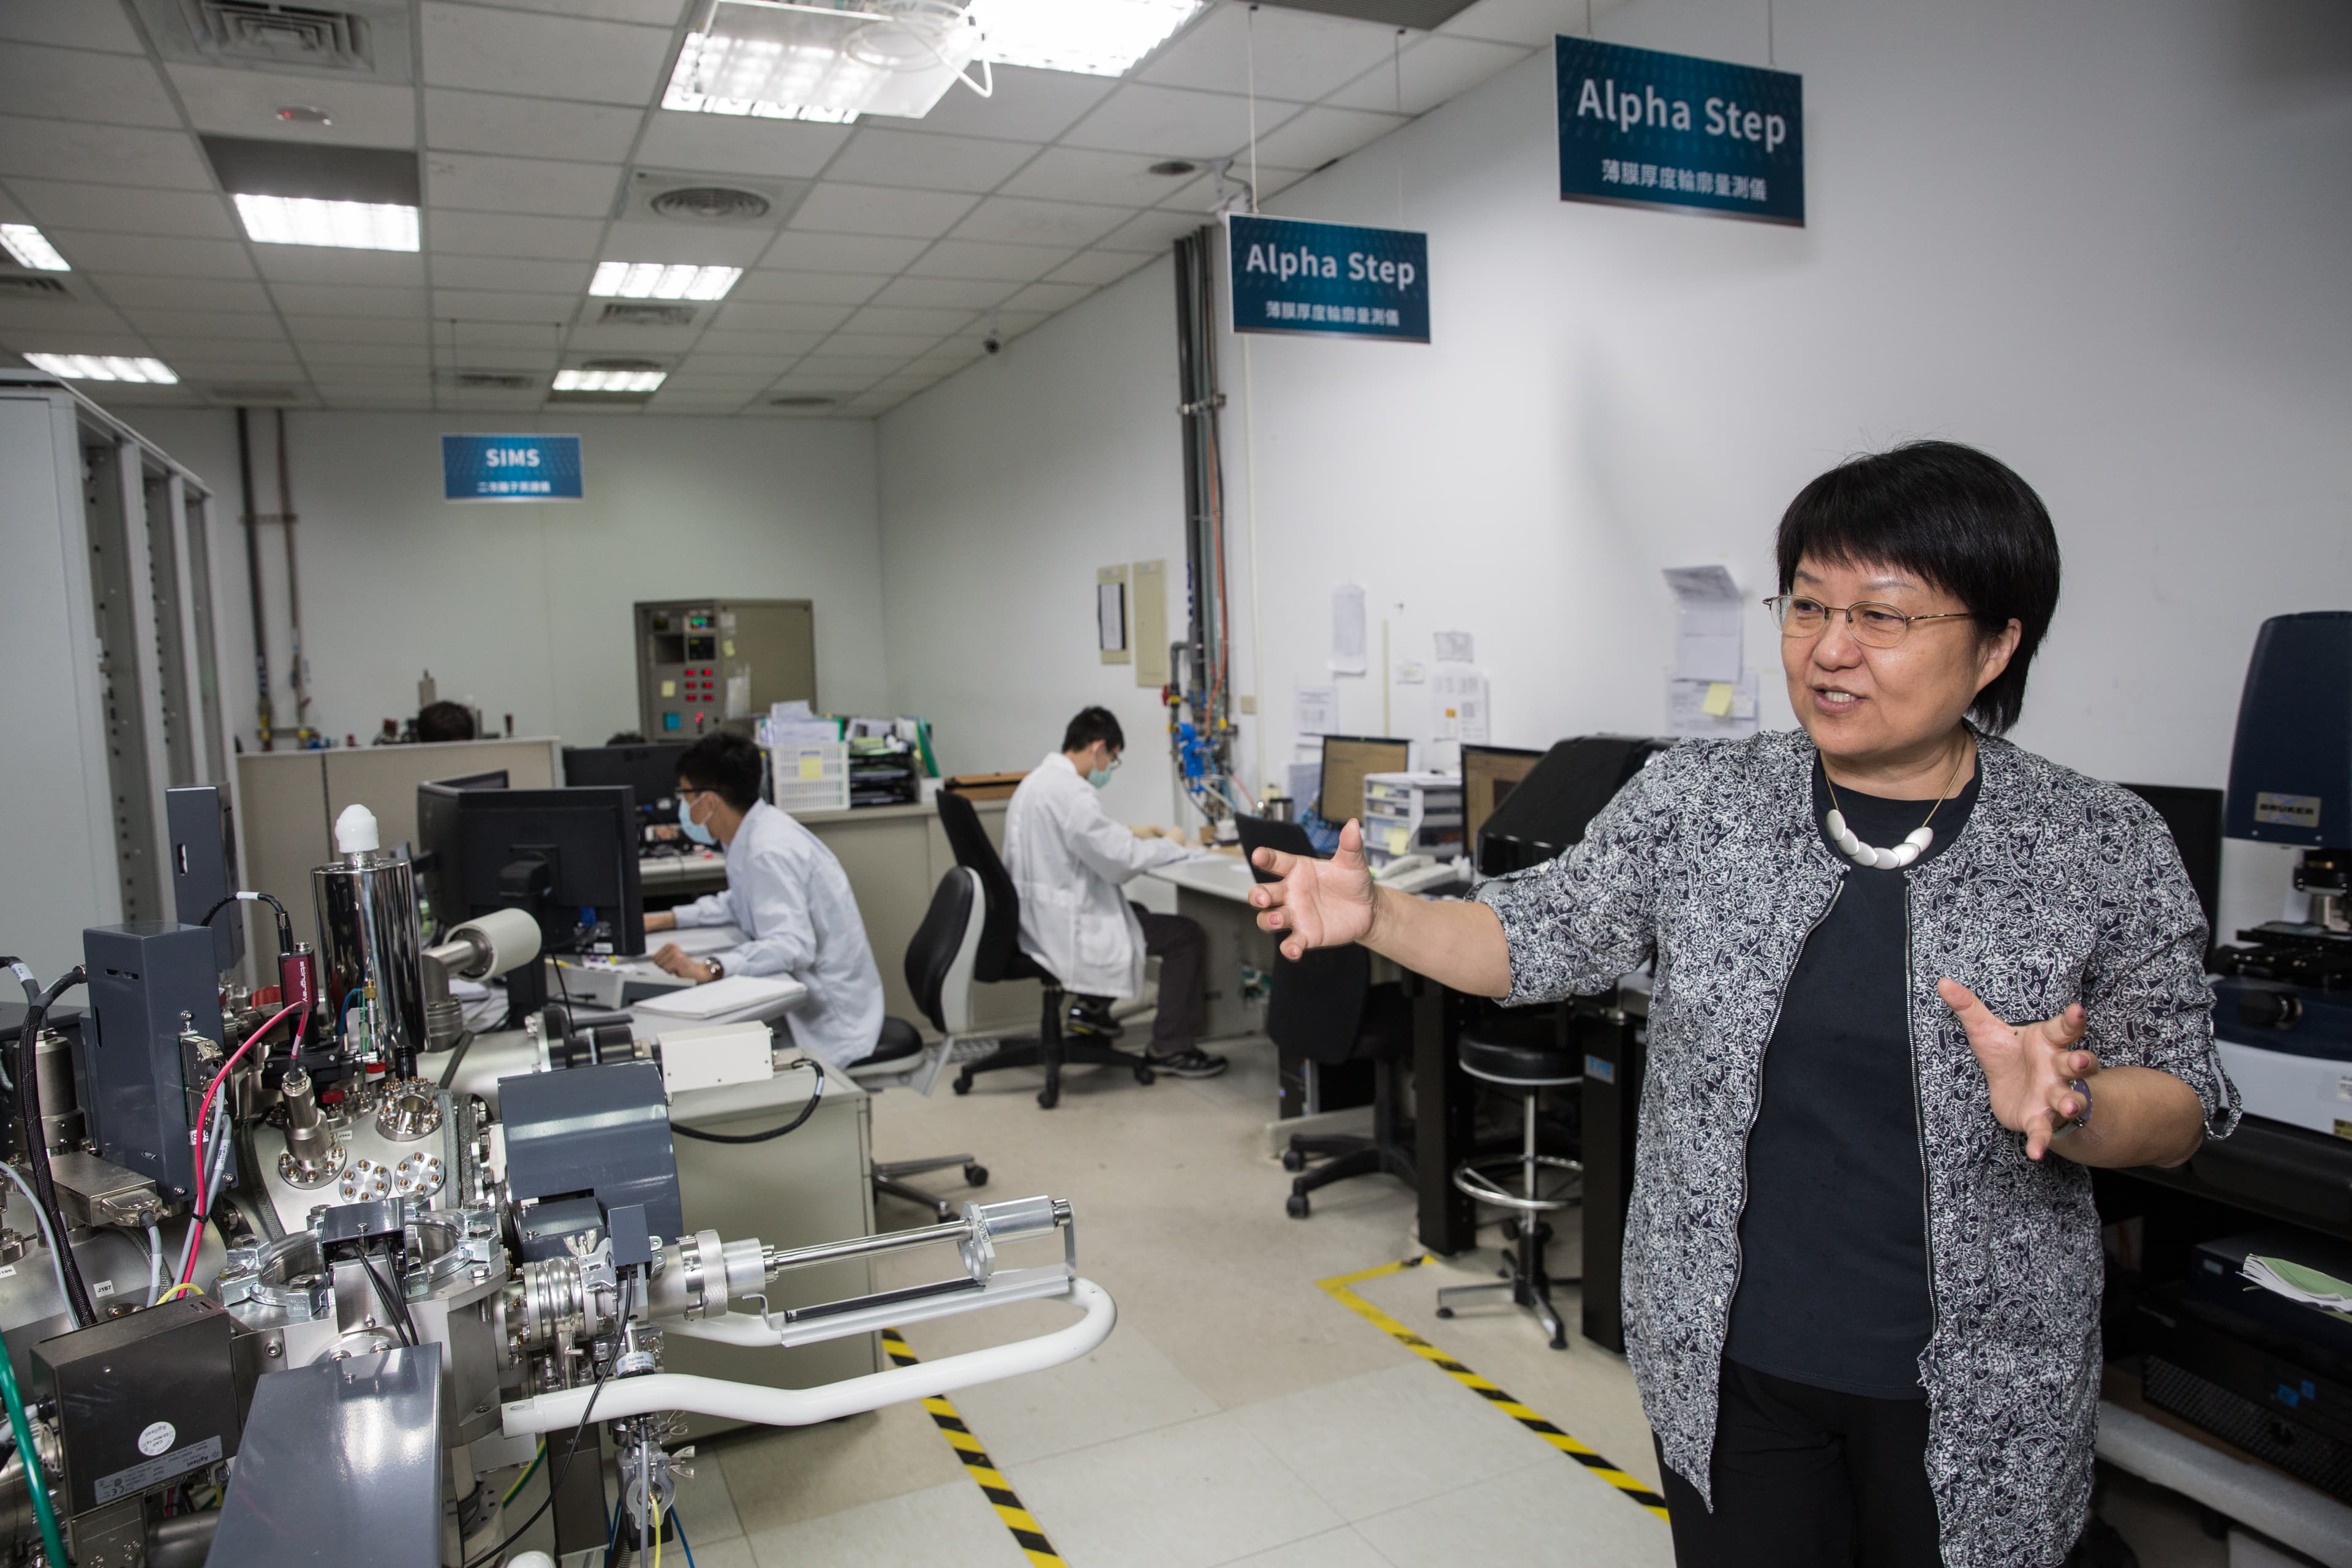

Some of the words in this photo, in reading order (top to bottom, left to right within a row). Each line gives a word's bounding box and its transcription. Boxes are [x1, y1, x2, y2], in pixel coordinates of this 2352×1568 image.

[1577, 78, 1691, 133] Alpha
[1705, 96, 1787, 153] Step
[1601, 158, 1768, 202] 薄膜厚度輪廓量測儀
[1245, 243, 1339, 282] Alpha
[1348, 251, 1415, 292] Step
[485, 448, 540, 467] SIMS
[300, 961, 308, 1002] stingray
[977, 1219, 990, 1244] UNLOCK
[145, 1425, 167, 1437] Agilent
[187, 1455, 209, 1467] Agilent
